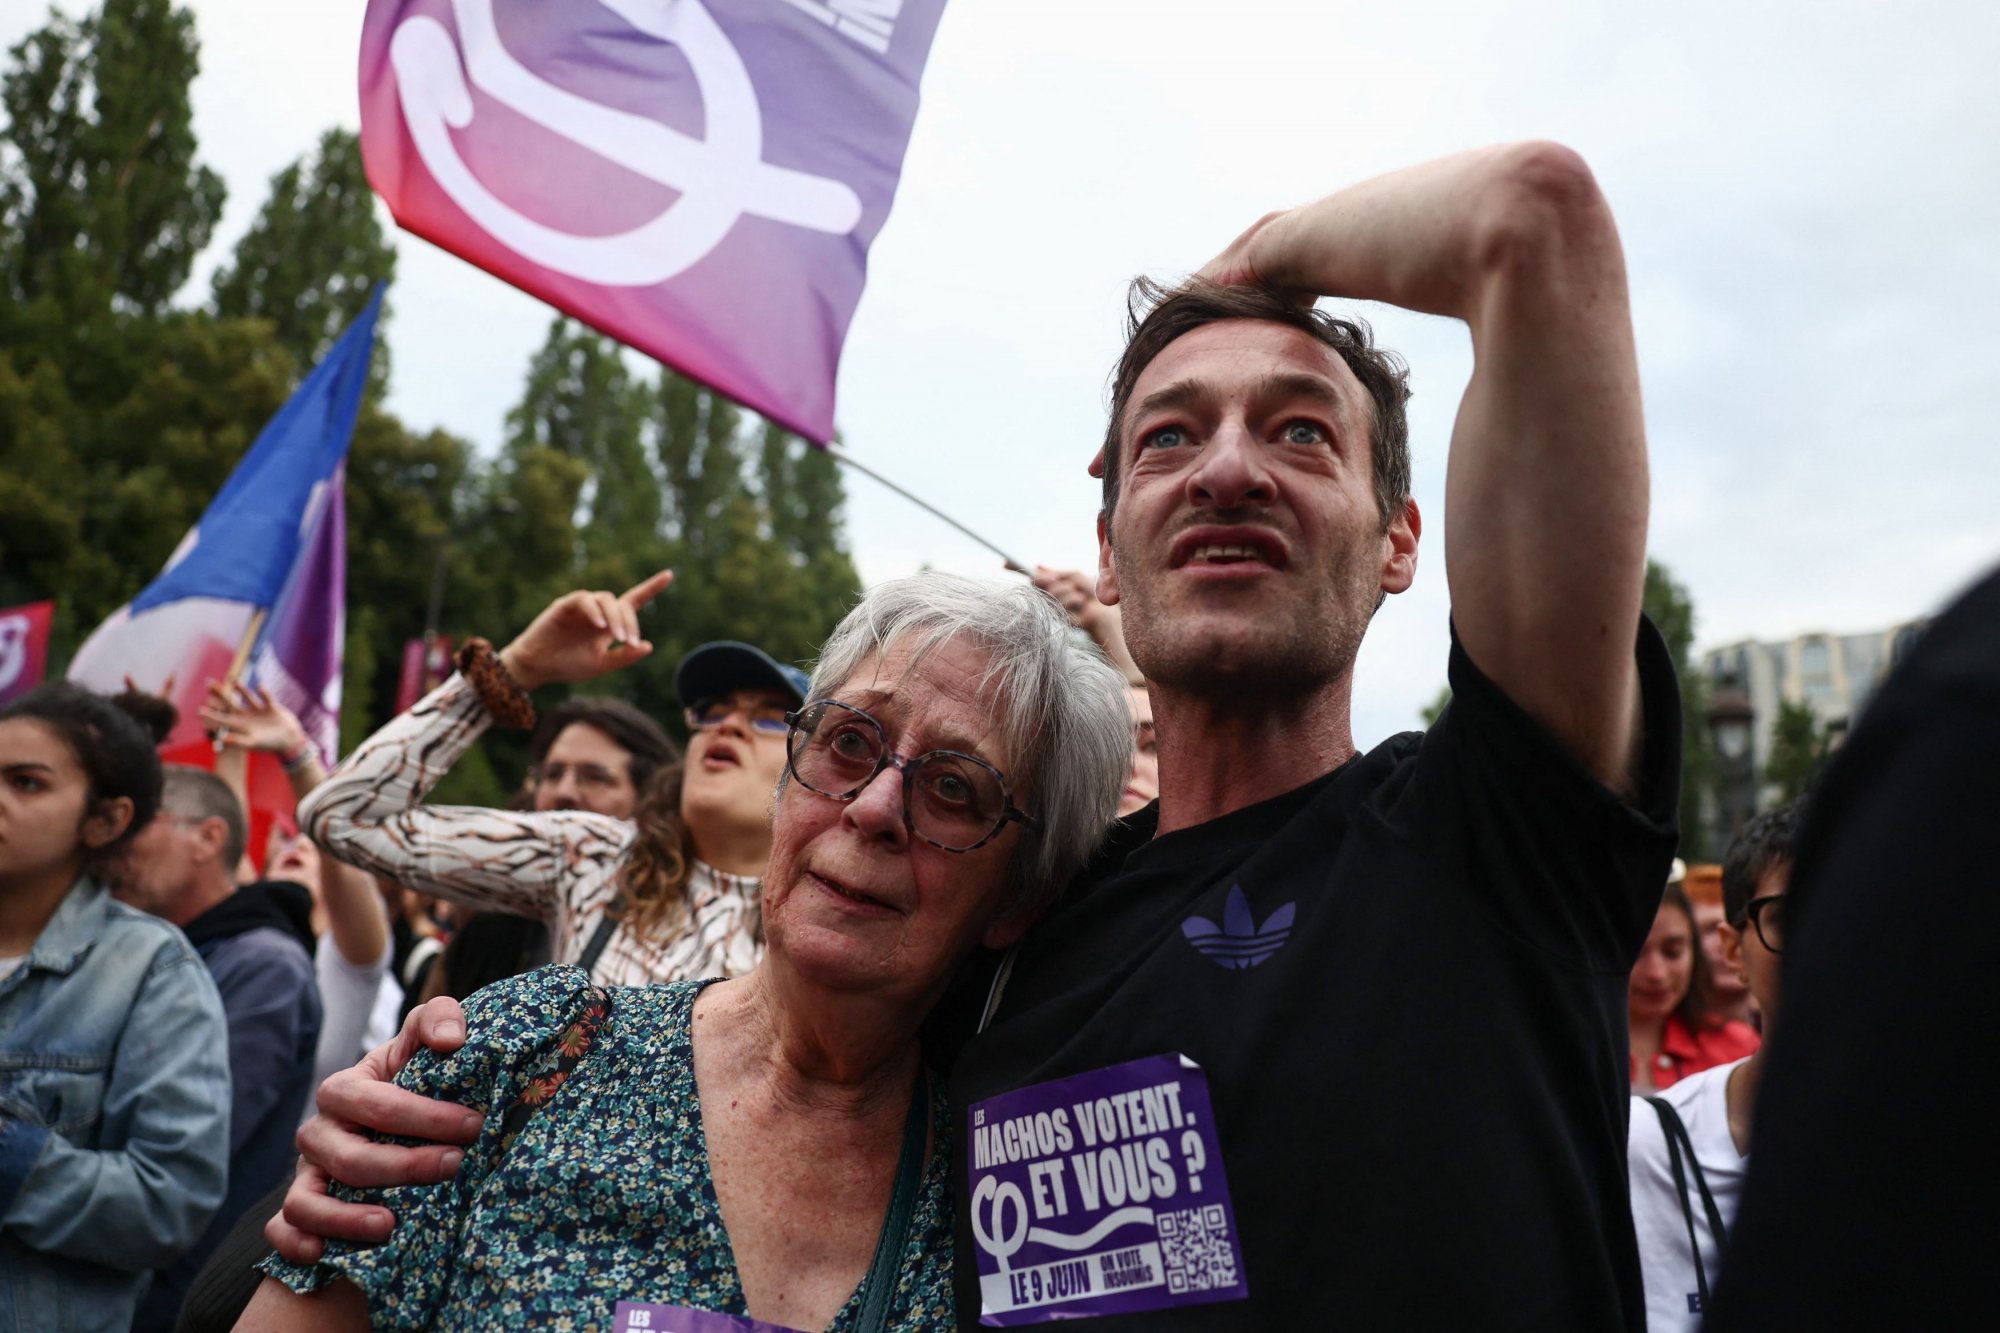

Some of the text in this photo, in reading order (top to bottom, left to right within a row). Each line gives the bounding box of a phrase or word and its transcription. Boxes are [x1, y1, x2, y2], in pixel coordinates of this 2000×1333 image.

[974, 1108, 985, 1126] LES
[974, 1081, 1196, 1170] MACHOS VOTENT.
[1028, 1158, 1068, 1220] ET
[1071, 1137, 1177, 1212] VOUS
[1100, 1249, 1142, 1271] ON VOTE
[1010, 1260, 1091, 1306] LE 9 JUIN
[628, 1309, 651, 1327] LES
